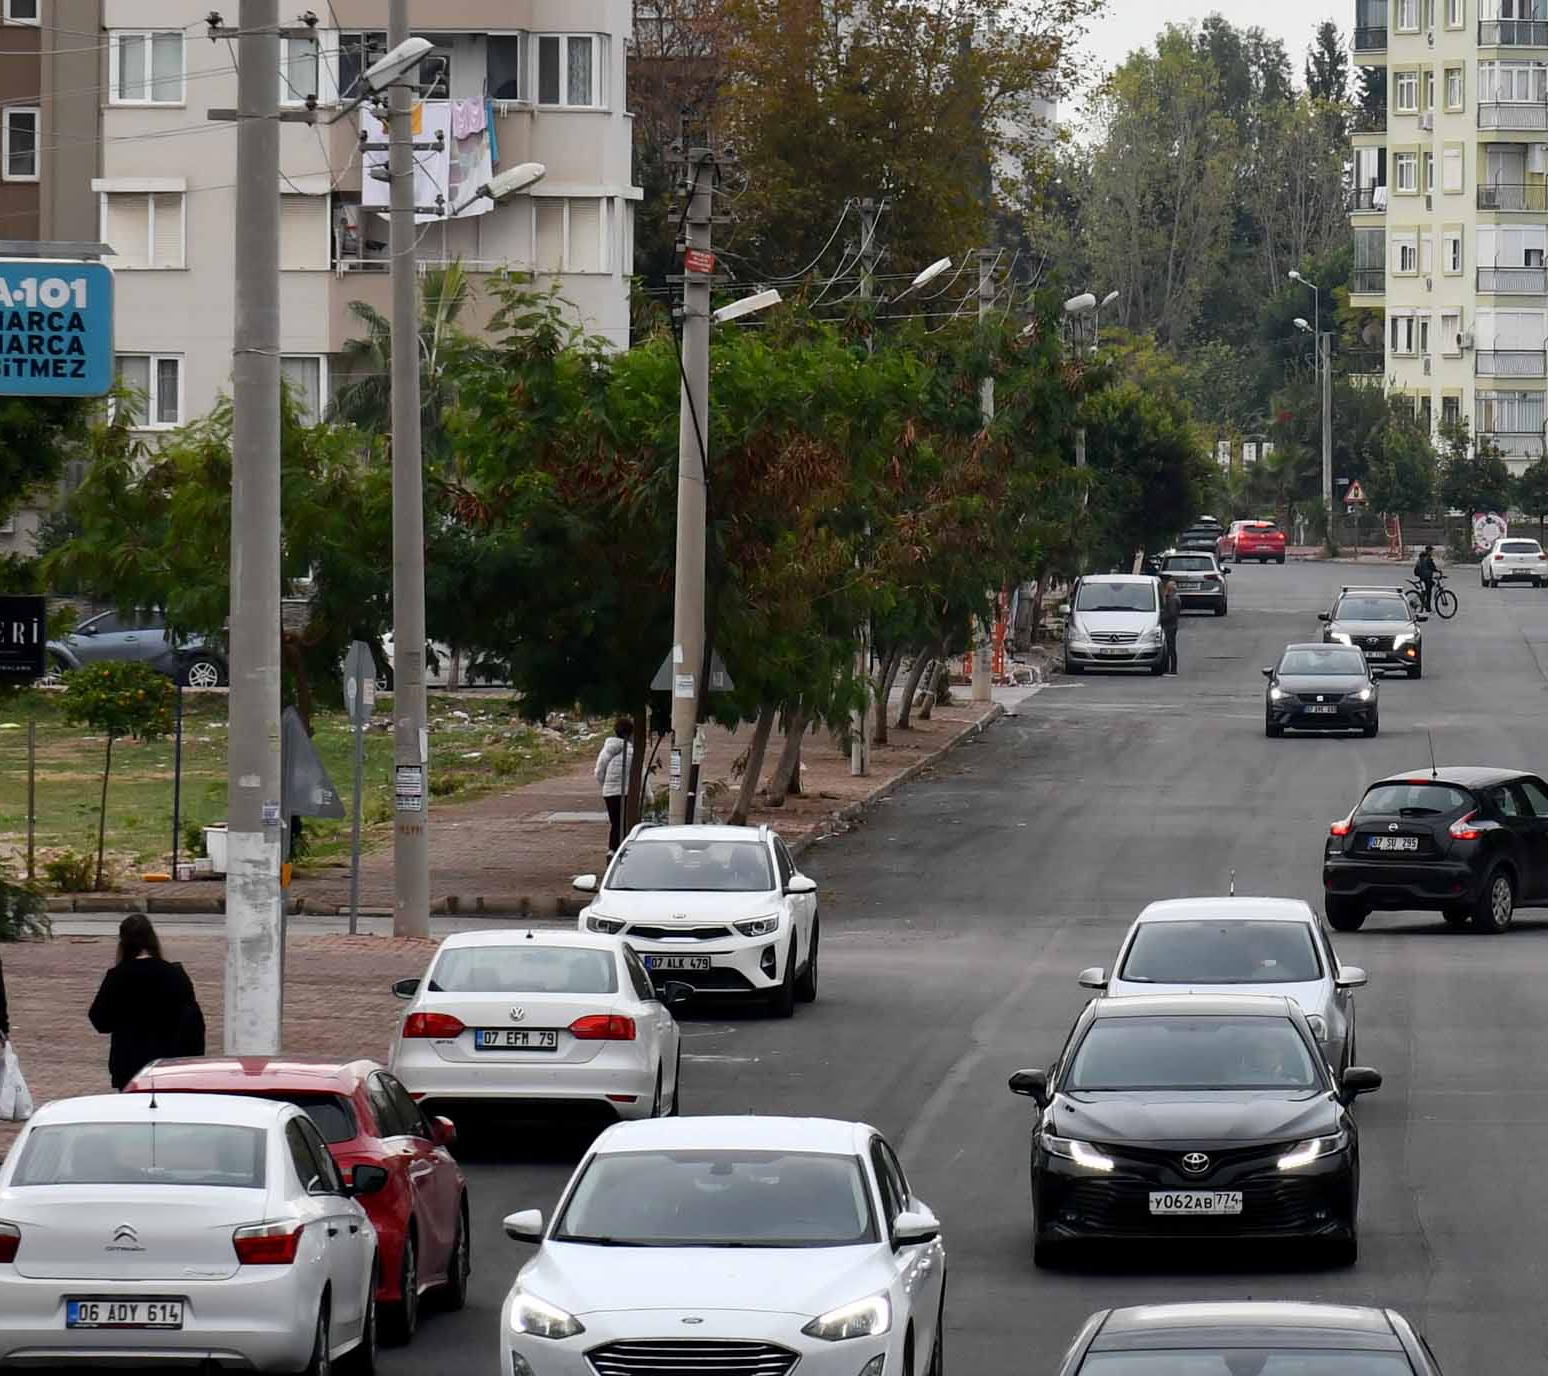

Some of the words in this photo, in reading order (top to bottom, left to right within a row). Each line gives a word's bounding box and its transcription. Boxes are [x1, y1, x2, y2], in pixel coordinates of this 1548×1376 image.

[651, 958, 662, 968] 07
[667, 958, 685, 969] ALK
[690, 958, 708, 969] 479
[484, 1031, 497, 1044] 07
[506, 1031, 529, 1045] EFM
[539, 1032, 554, 1045] 79
[78, 1304, 99, 1322] 06
[107, 1304, 139, 1322] ADY
[147, 1304, 179, 1322] 614
